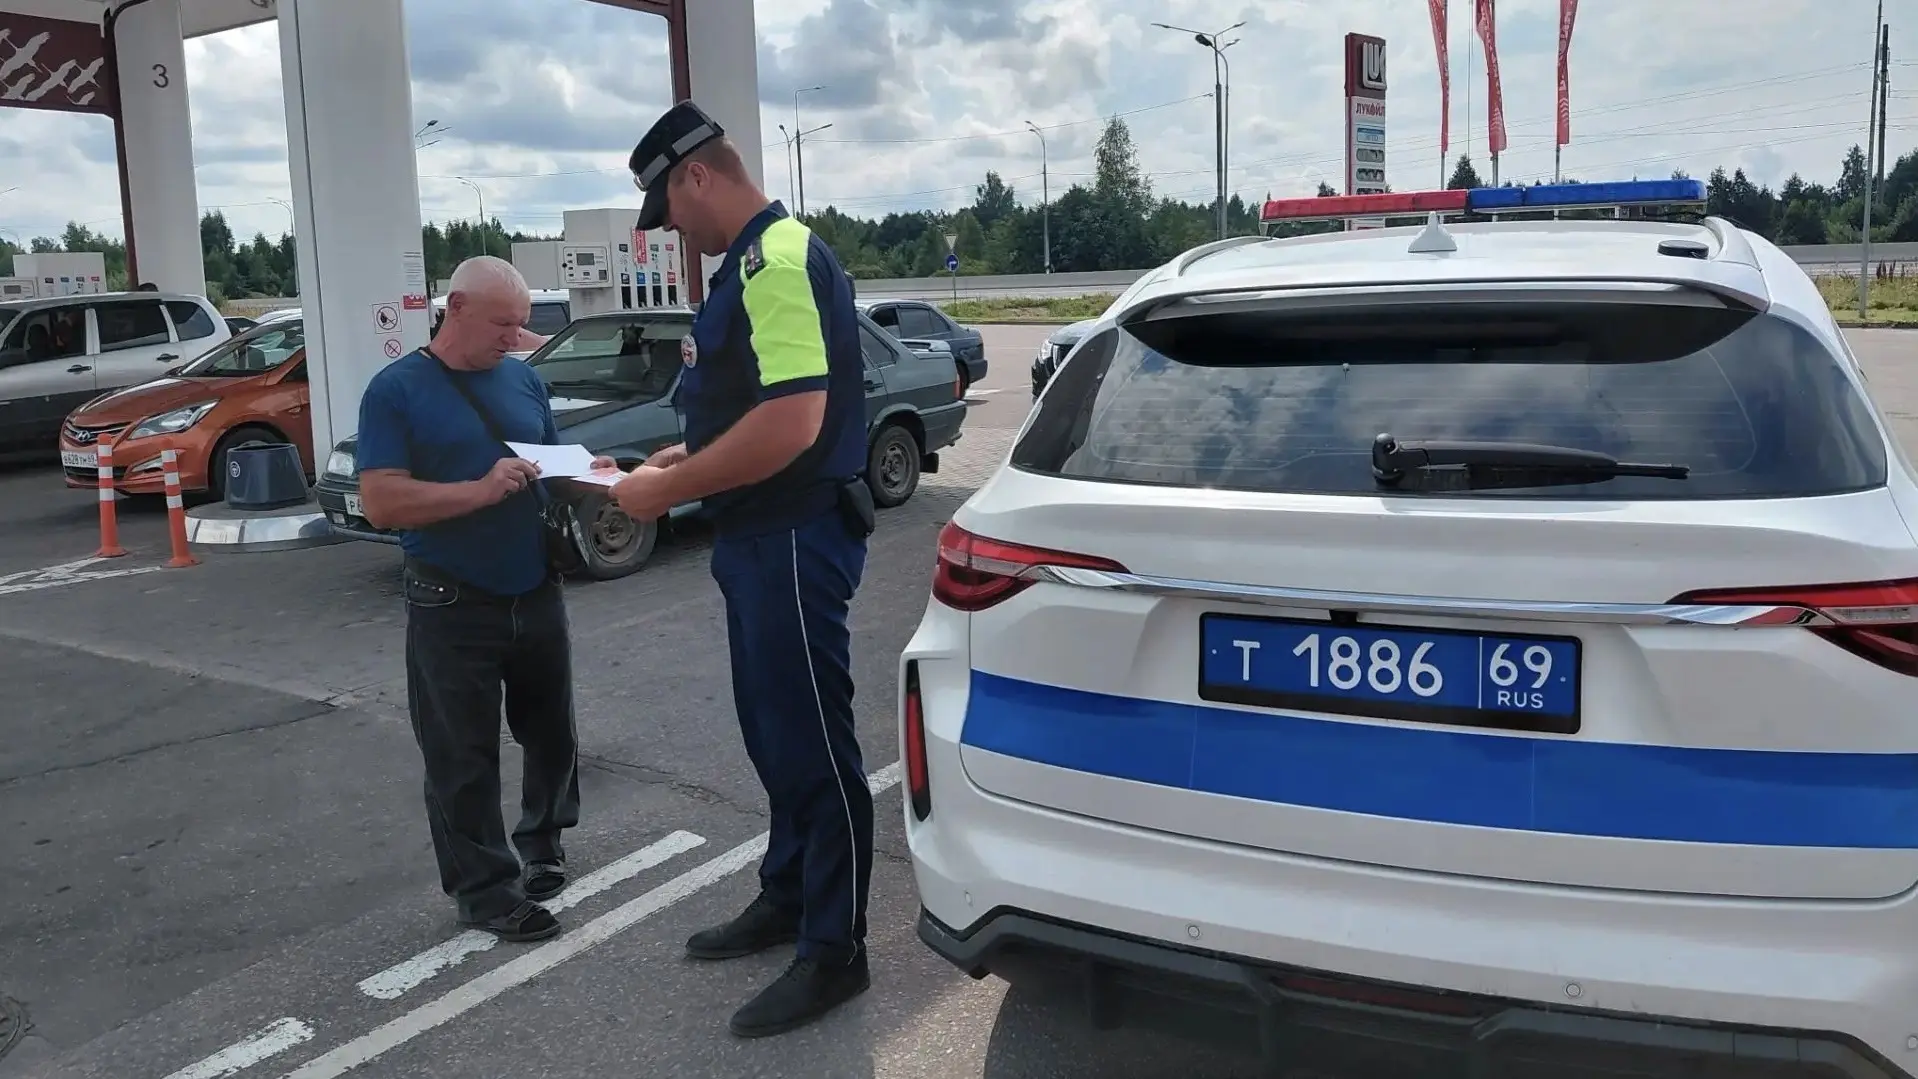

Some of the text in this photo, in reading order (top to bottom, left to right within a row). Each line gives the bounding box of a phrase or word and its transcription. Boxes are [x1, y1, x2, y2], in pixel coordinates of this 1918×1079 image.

[152, 63, 169, 88] 3
[1233, 633, 1552, 697] Т 1886 69
[1497, 690, 1544, 709] RUS
